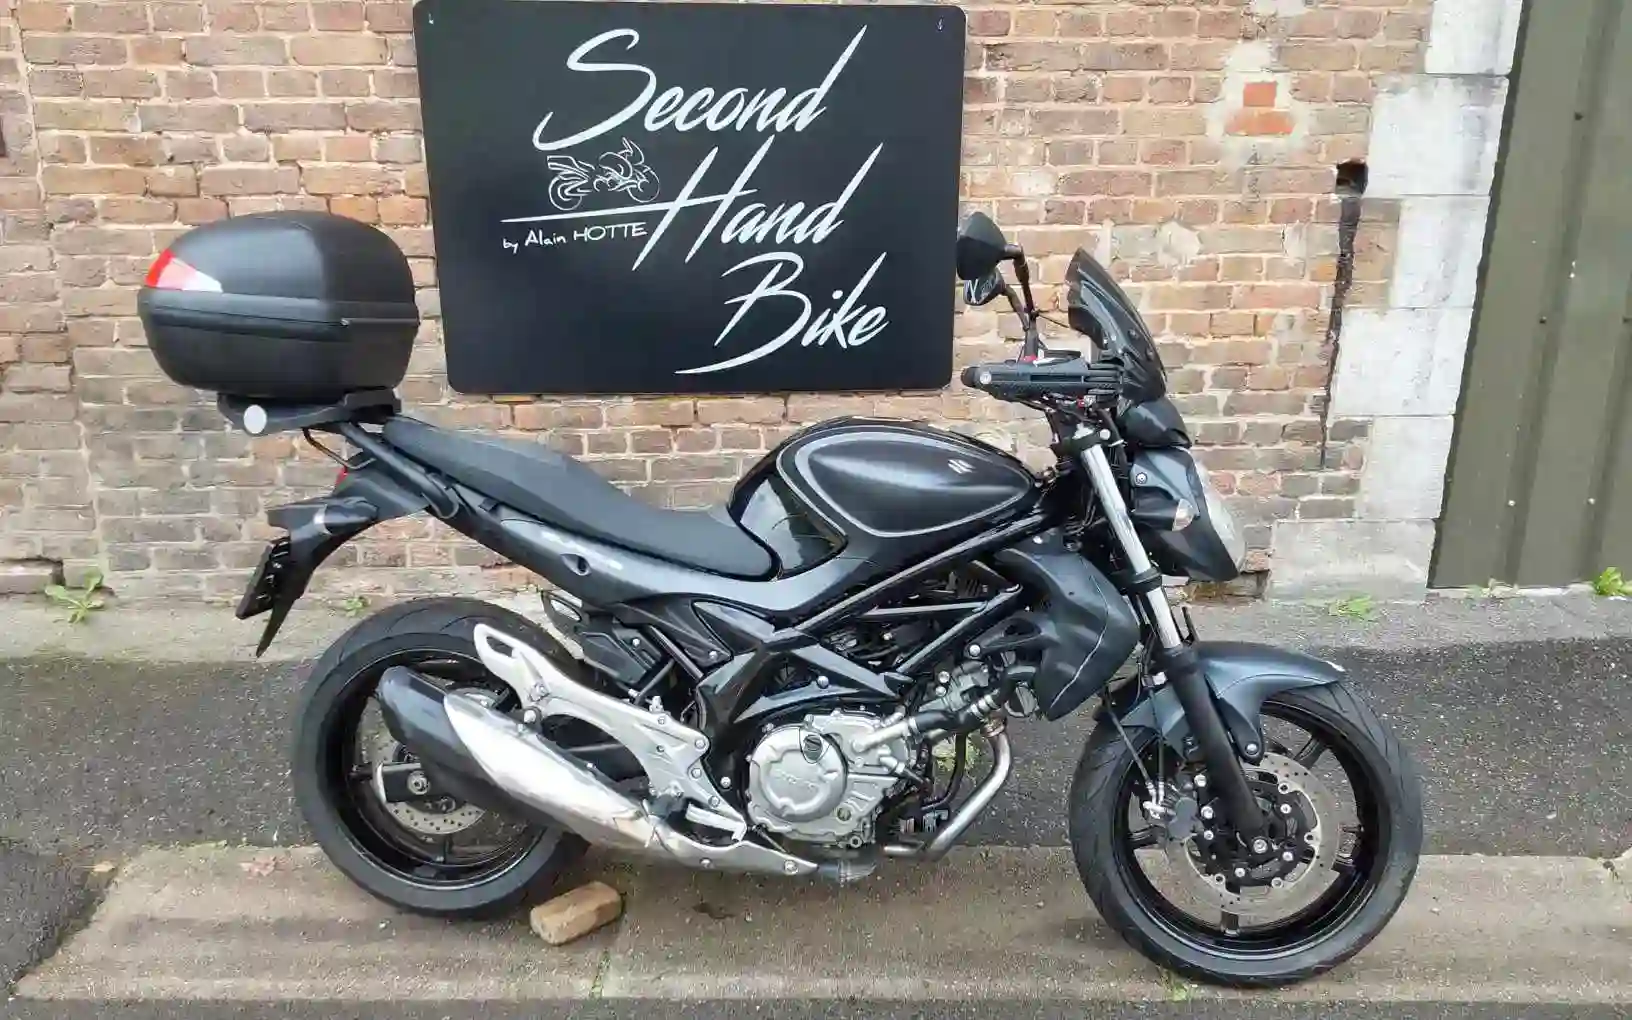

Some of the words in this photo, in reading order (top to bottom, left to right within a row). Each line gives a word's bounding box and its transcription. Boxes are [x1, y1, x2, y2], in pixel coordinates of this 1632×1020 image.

[531, 25, 868, 151] Second
[502, 238, 519, 254] by
[524, 229, 567, 246] Alain
[573, 221, 648, 242] HOTTE
[631, 134, 884, 271] Hand
[675, 251, 889, 374] Bike
